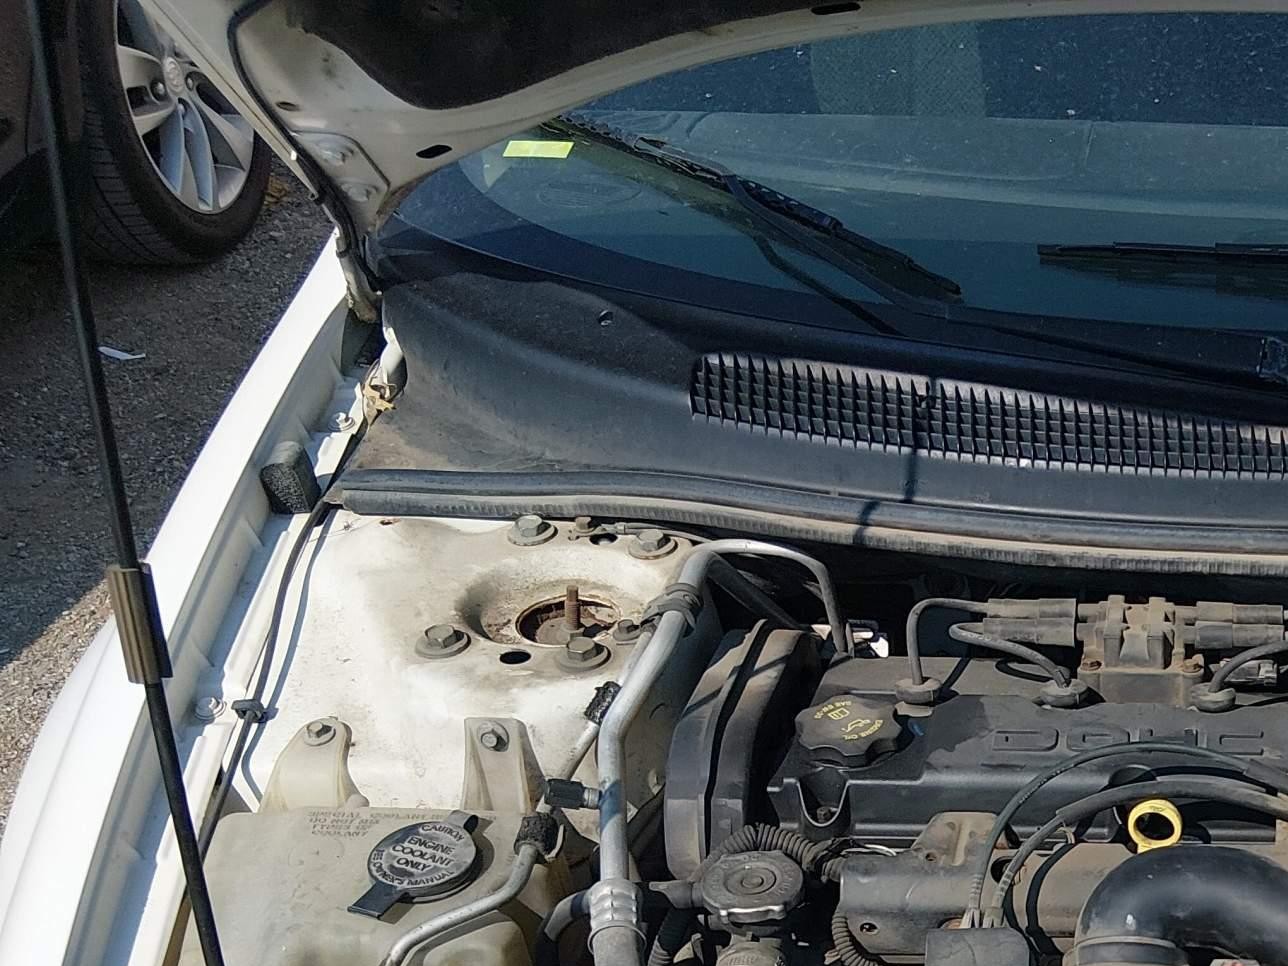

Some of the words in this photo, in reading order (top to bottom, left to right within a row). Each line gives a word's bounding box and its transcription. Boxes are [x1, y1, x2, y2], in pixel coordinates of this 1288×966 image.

[420, 824, 465, 842] CAUTION
[406, 836, 455, 856] ENGINE
[391, 844, 455, 867] COOLANT
[396, 857, 431, 872] ONLY
[406, 871, 456, 886] MANUAL
